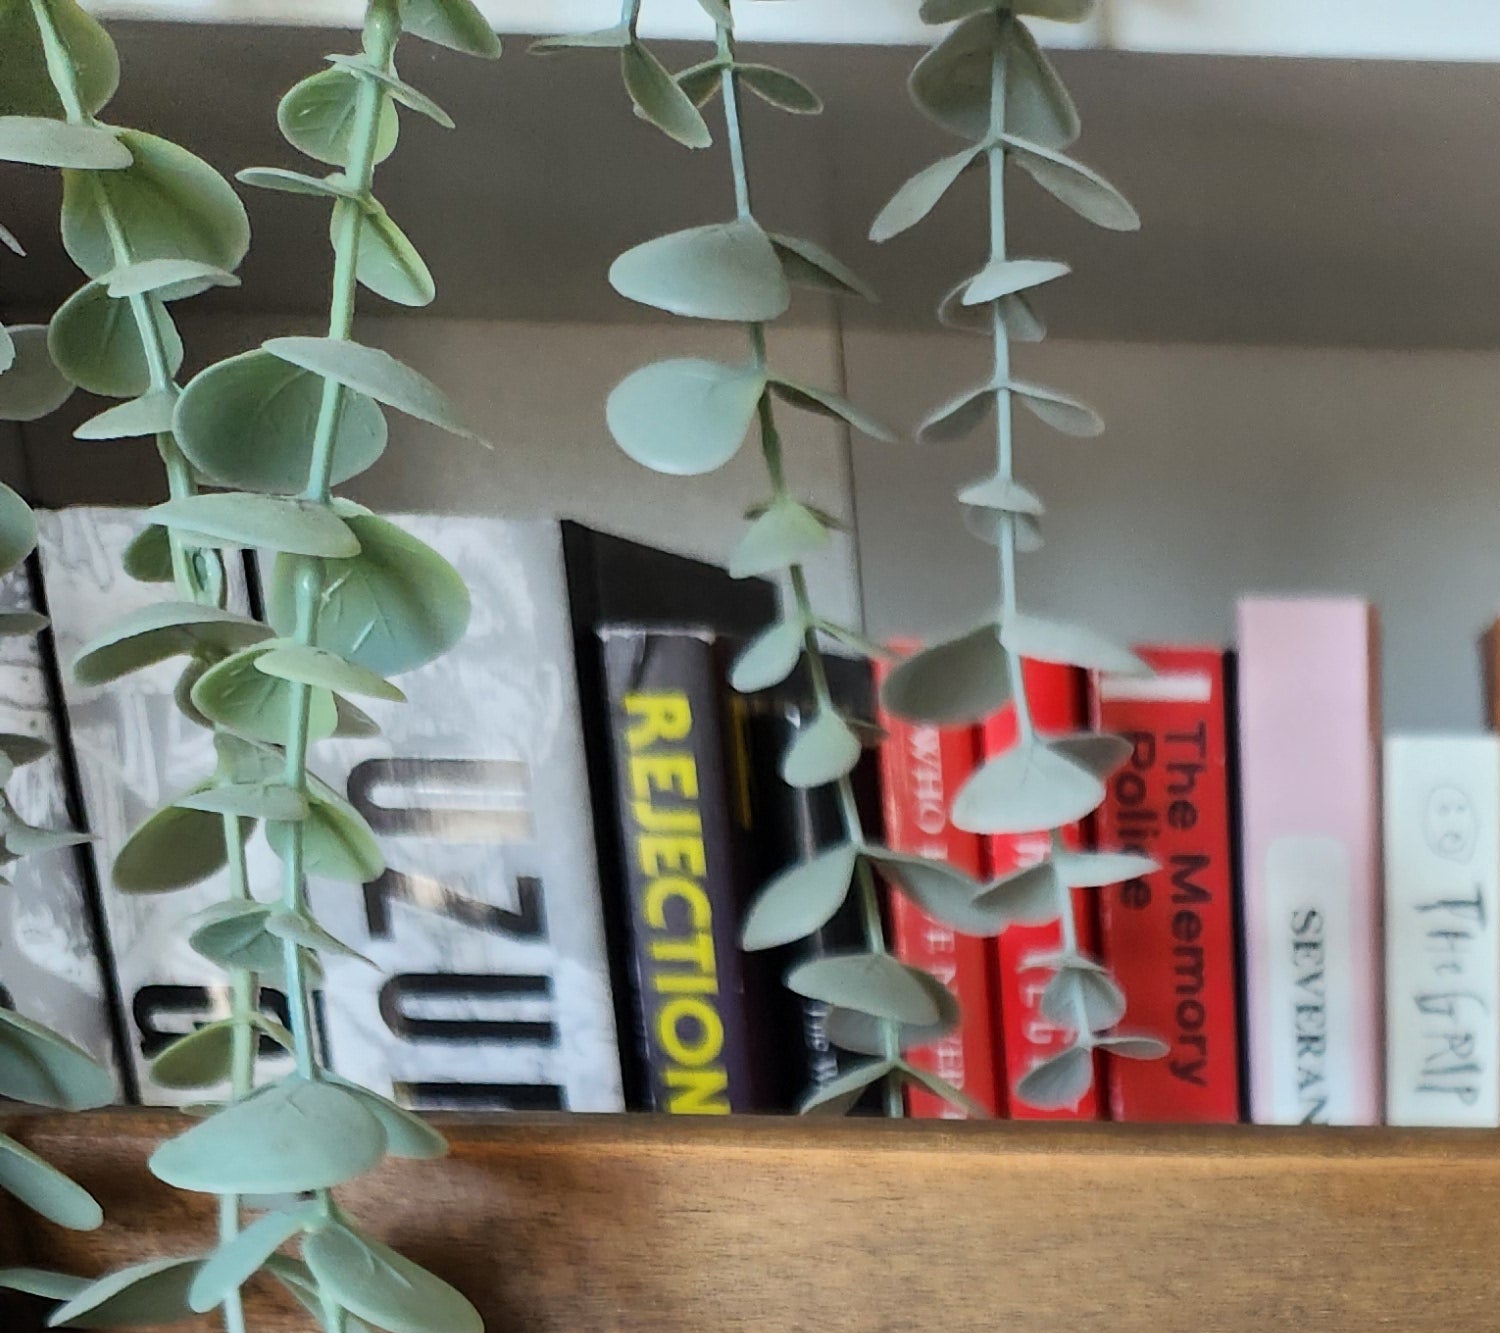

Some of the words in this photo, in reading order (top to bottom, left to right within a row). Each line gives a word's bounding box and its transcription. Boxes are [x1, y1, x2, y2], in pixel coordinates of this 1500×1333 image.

[1165, 721, 1207, 831] The
[626, 690, 731, 1115] REJECTION
[1168, 852, 1213, 1088] Memory
